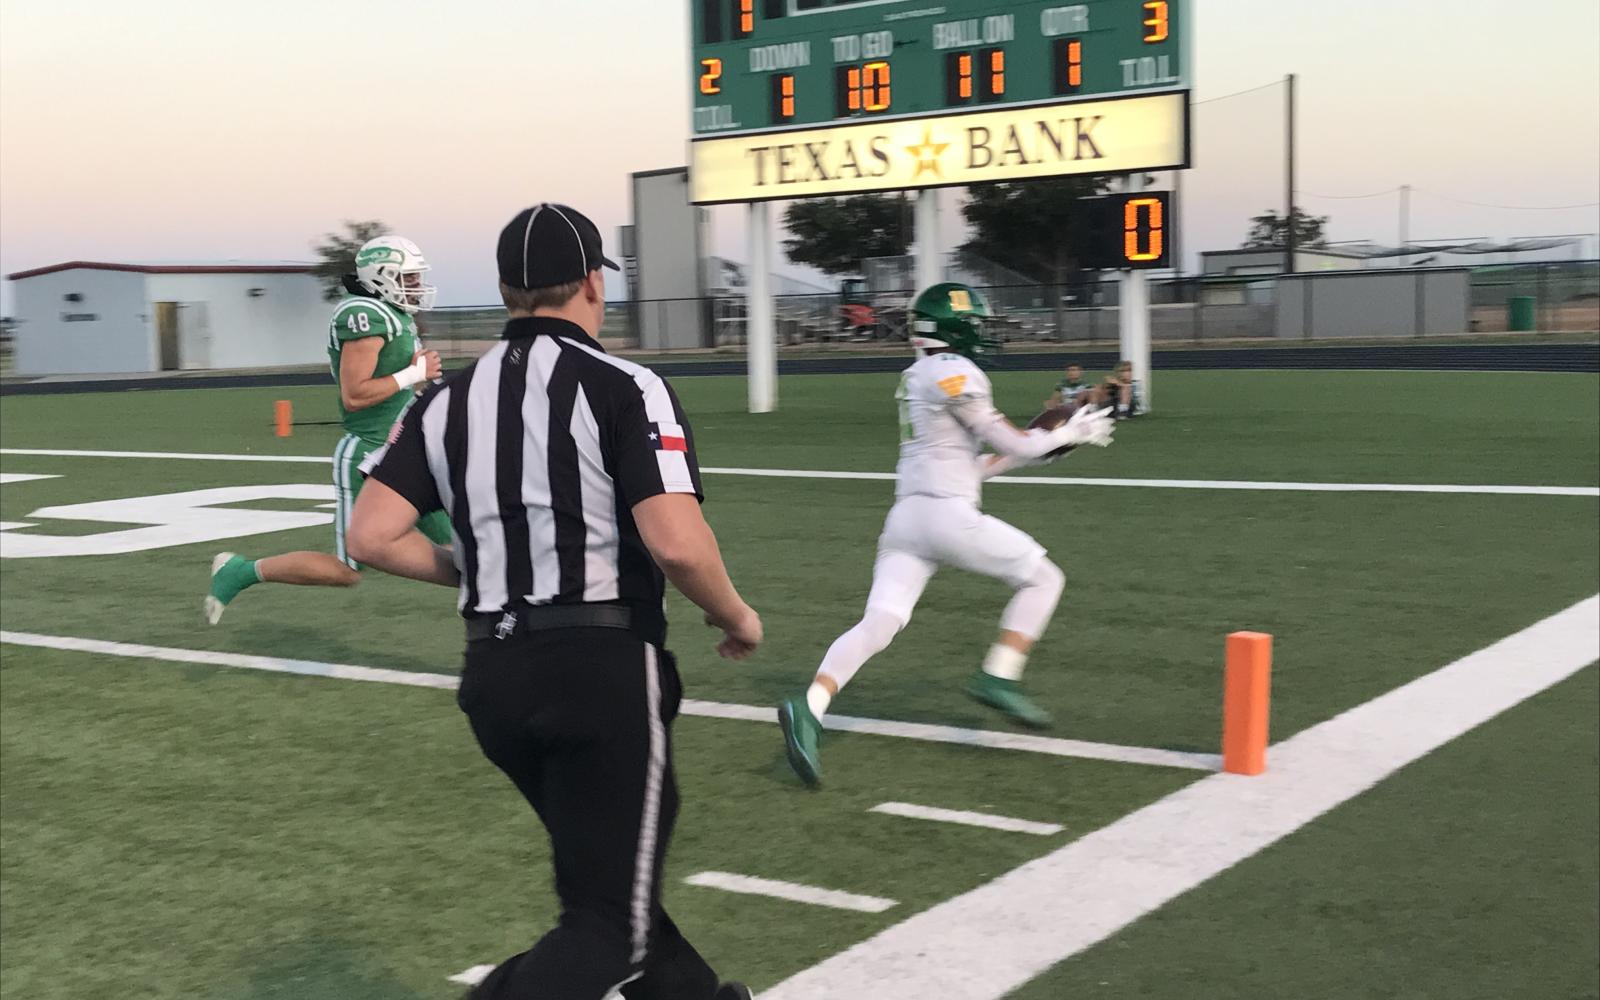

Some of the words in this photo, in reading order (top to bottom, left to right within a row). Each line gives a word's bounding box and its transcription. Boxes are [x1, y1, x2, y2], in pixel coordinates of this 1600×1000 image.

[932, 18, 984, 50] BALL
[982, 14, 1015, 44] ON
[1143, 1, 1169, 43] 3
[749, 41, 811, 73] DOWN
[830, 34, 860, 62] TO
[861, 30, 894, 59] GO
[1068, 41, 1082, 86] 1
[700, 58, 722, 94] 2
[782, 76, 795, 117] 1
[847, 62, 891, 111] 10
[746, 136, 892, 187] TEXAS
[964, 114, 1107, 170] BANK
[1124, 198, 1163, 261] 0
[347, 312, 371, 333] 48
